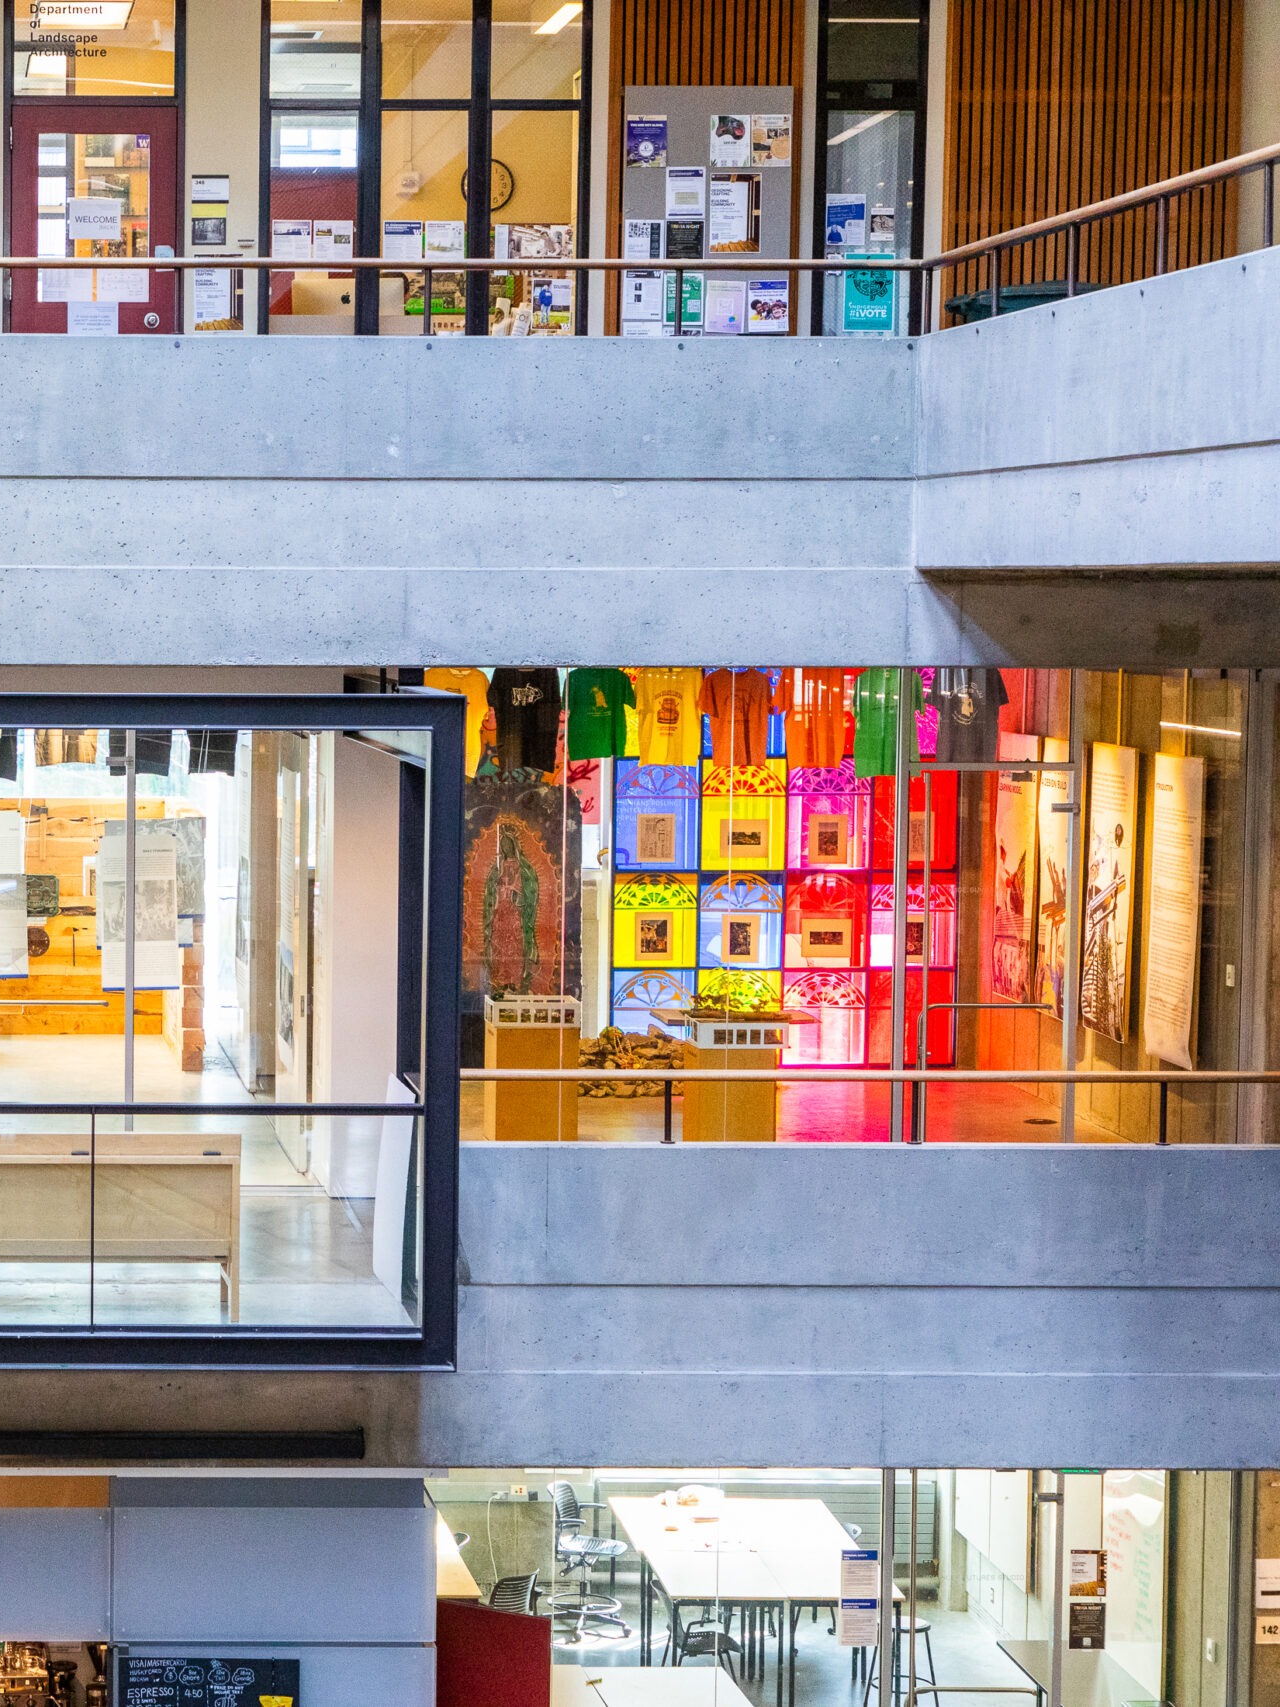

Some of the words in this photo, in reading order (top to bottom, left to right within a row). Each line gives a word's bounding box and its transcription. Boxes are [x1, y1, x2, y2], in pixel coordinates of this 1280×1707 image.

[30, 4, 103, 15] Department
[30, 18, 41, 29] of
[30, 32, 98, 44] Landscape
[30, 47, 107, 57] Architecture
[138, 139, 149, 148] W
[75, 215, 118, 224] WELCOME
[1261, 1625, 1279, 1635] 142
[127, 1687, 174, 1699] ESPRESSO
